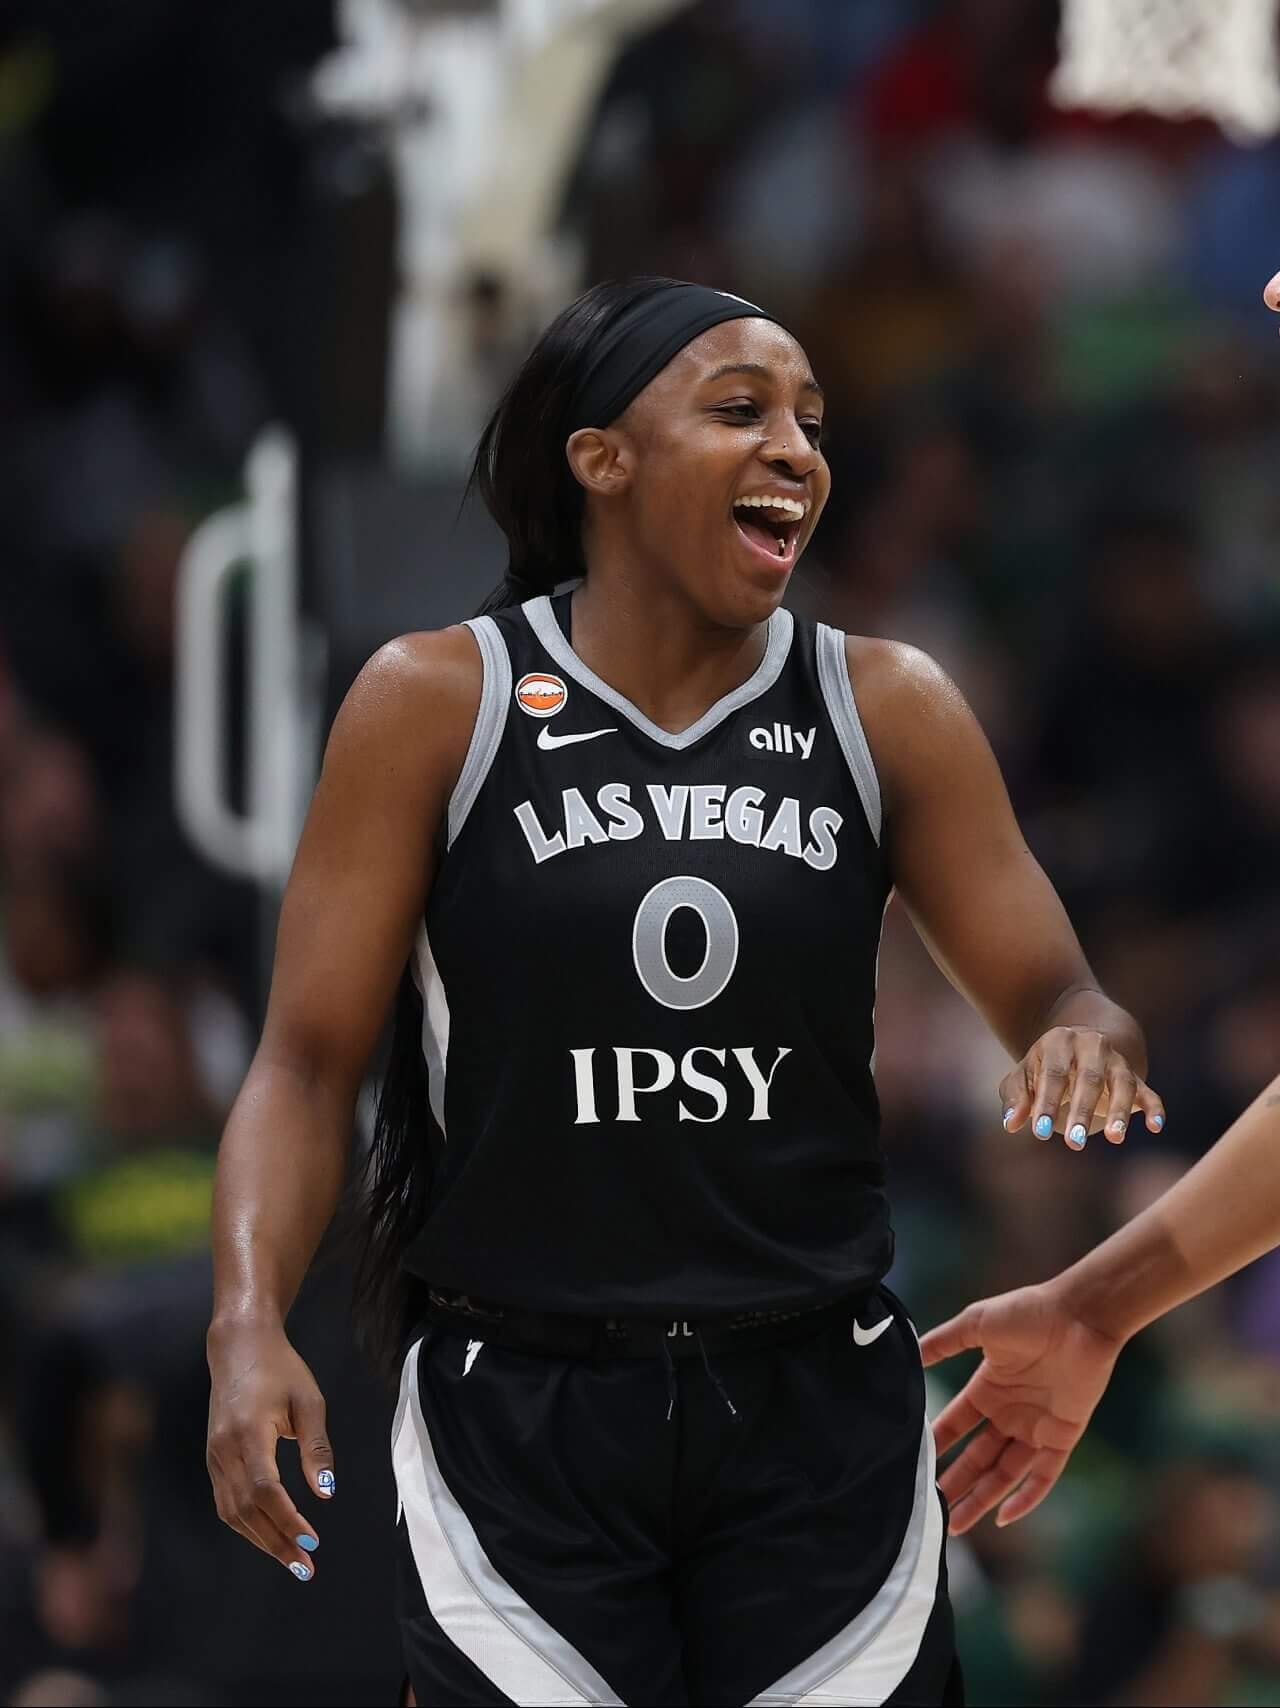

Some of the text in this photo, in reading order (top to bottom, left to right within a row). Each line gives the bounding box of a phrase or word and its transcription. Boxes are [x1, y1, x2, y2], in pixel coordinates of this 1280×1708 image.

[749, 722, 816, 759] ally
[513, 783, 844, 870] LAS VEGAS
[632, 875, 739, 1010] 0
[569, 1046, 793, 1124] IPSY
